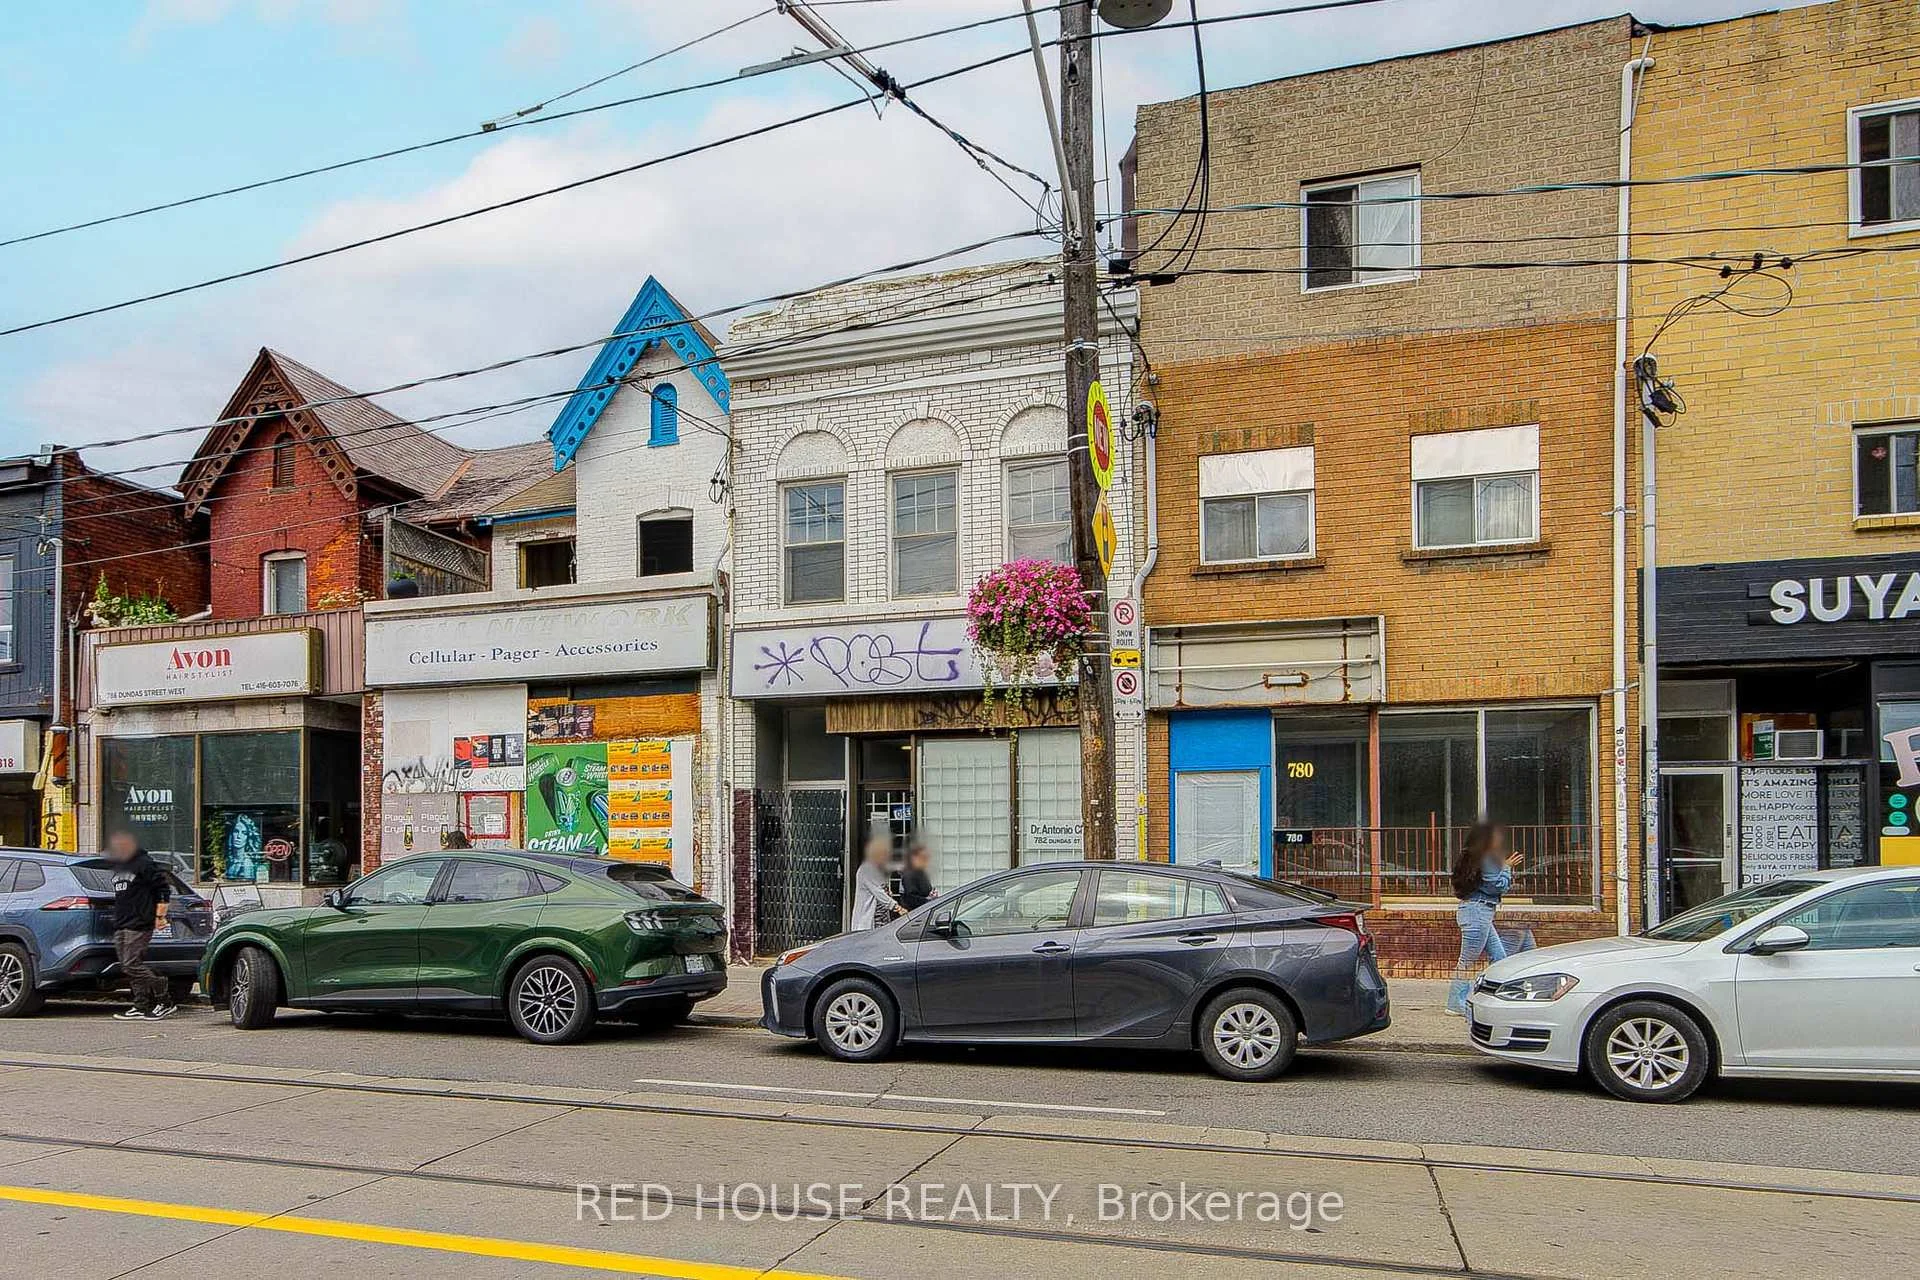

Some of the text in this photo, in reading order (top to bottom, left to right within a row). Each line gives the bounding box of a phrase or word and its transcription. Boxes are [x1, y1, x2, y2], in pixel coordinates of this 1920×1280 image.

[1770, 573, 1920, 624] SUYA
[1117, 629, 1133, 637] SNOW
[1116, 638, 1135, 647] ROUTE
[409, 650, 477, 666] Cellular
[491, 646, 540, 664] Pager
[555, 637, 659, 657] Accessories
[167, 647, 232, 671] Avon
[166, 670, 234, 680] HAIRSTYLIST
[118, 689, 143, 699] DUNDAS
[144, 688, 167, 697] STREET
[168, 687, 186, 695] WEST
[1287, 762, 1314, 778] 780
[1763, 778, 1818, 787] AMAZING
[124, 785, 173, 804] Avon
[1741, 790, 1772, 799] MORE
[1775, 790, 1802, 799] LOVE
[1759, 802, 1796, 811] HAPPY
[1286, 833, 1304, 842] 780
[1741, 825, 1754, 849] FUN
[1778, 825, 1817, 840] EAT
[266, 843, 290, 857] OPEN
[1777, 841, 1817, 850] HAPPY
[1741, 853, 1788, 861] DELICIOUS
